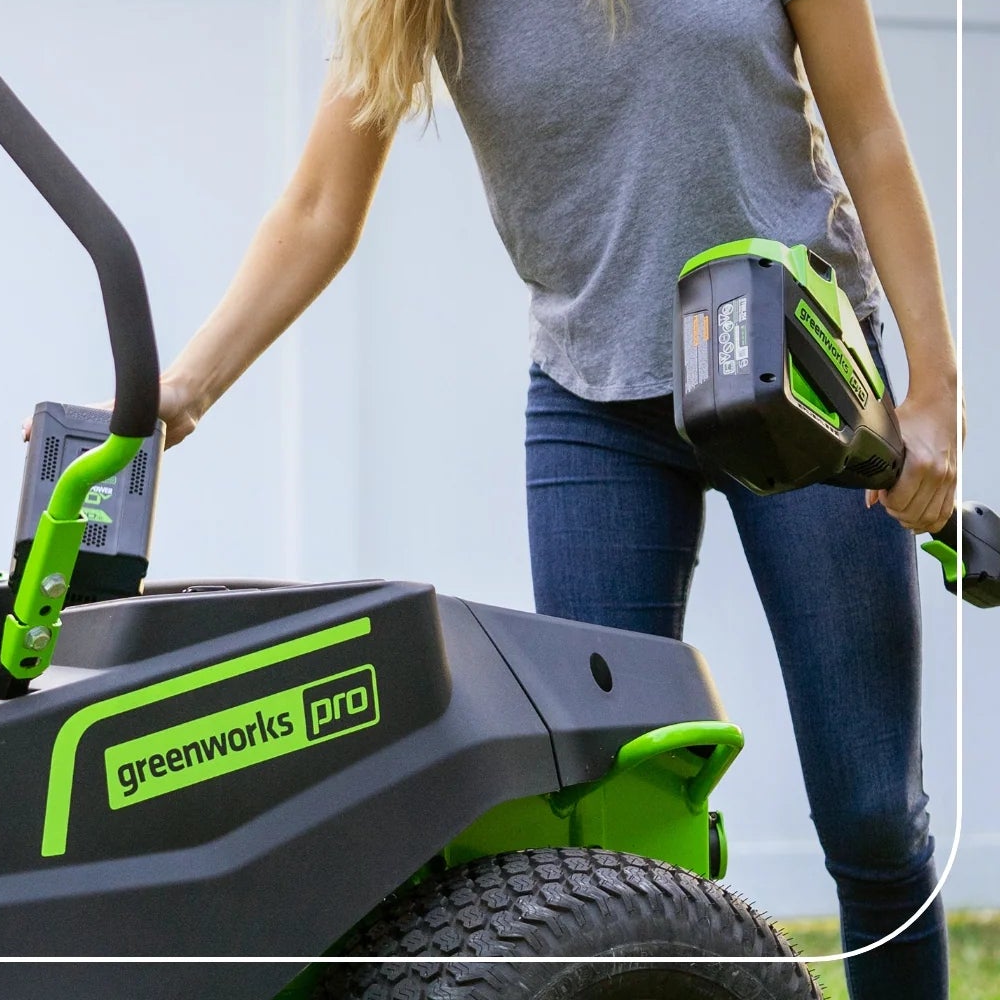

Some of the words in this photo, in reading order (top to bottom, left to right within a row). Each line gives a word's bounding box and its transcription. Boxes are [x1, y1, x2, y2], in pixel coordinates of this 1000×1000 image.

[799, 306, 849, 374] greenworks
[116, 709, 295, 798] greenworks
[309, 685, 369, 736] pro
